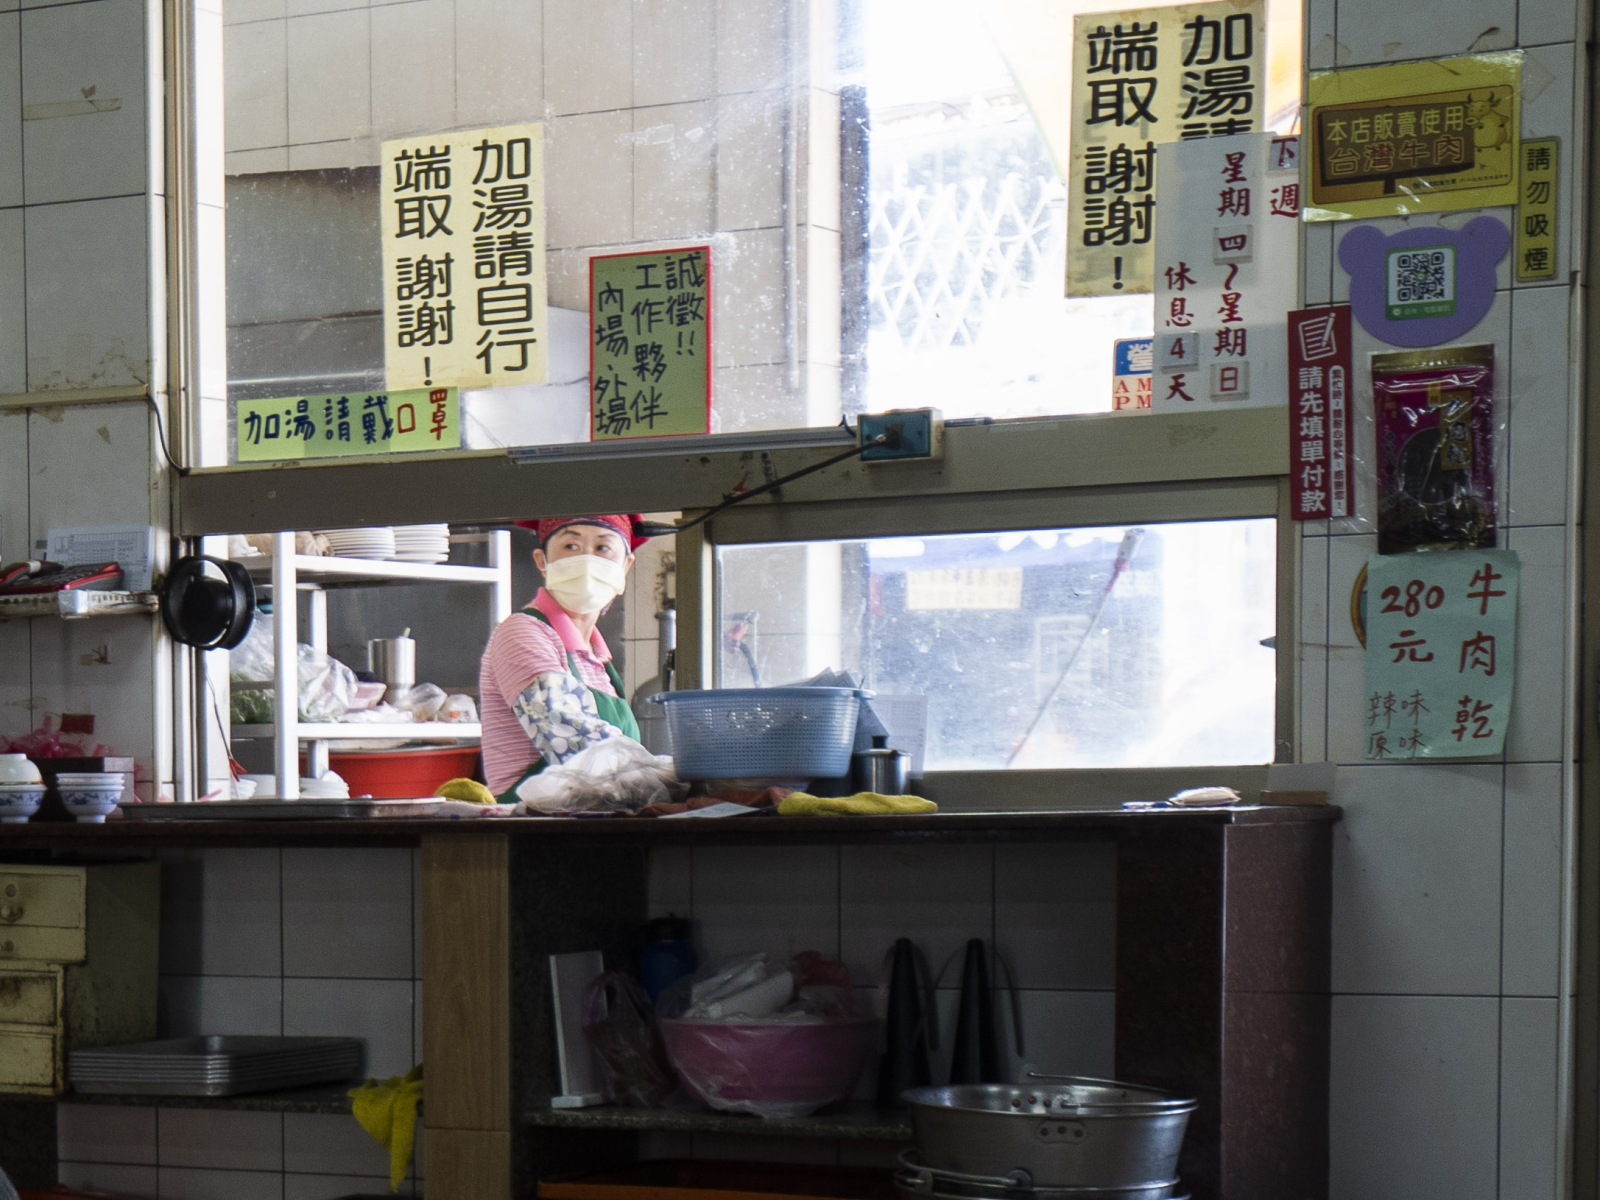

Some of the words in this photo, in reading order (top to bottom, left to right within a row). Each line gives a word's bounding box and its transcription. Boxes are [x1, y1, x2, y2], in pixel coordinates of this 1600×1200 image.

[1269, 137, 1299, 218] 下週
[1327, 105, 1464, 145] 本店販賣使用
[1328, 134, 1465, 176] 台灣牛肉
[472, 138, 538, 375] 加湯請自行
[1523, 146, 1552, 274] 請勿吸煙
[631, 264, 668, 430] 工作夥伴
[1163, 261, 1198, 402] 休息4天
[244, 389, 448, 445] 加湯請戴口罩
[1300, 366, 1327, 513] 請先填單付款
[1367, 688, 1431, 730] 辣味
[1451, 562, 1507, 743] 牛肉乾
